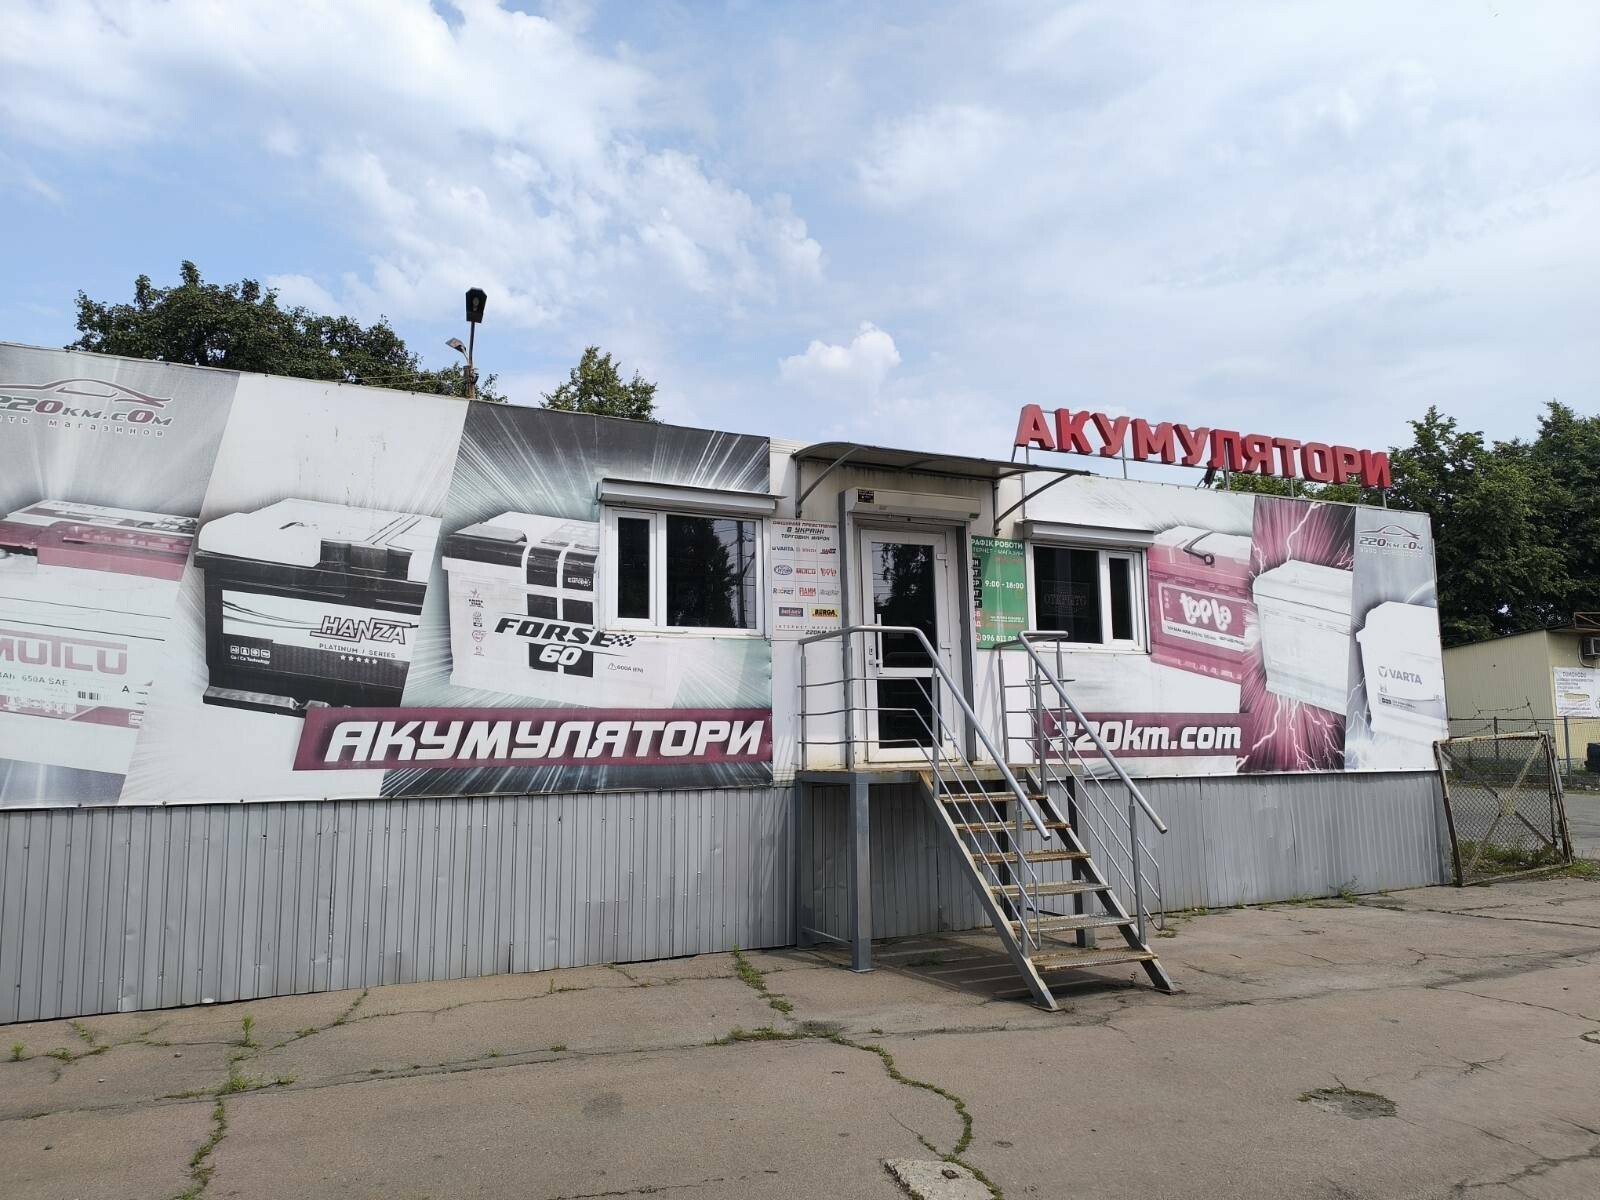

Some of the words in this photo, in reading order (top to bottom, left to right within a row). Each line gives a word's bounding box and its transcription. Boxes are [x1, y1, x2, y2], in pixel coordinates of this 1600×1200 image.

[49, 420, 165, 436] магазинов
[1015, 403, 1391, 489] АКУМУЛЯТОРИ
[971, 539, 994, 547] РАФІК
[995, 541, 1023, 549] РОБОТИ
[315, 616, 411, 644] HANZA
[495, 617, 617, 648] FORSE
[319, 643, 358, 655] PLATINUM
[368, 649, 396, 659] SERIES
[539, 643, 583, 666] 60
[1390, 668, 1423, 686] VARTA
[323, 719, 765, 763] АКУМУЛЯТОРИ
[1049, 719, 1242, 751] 220km.com
